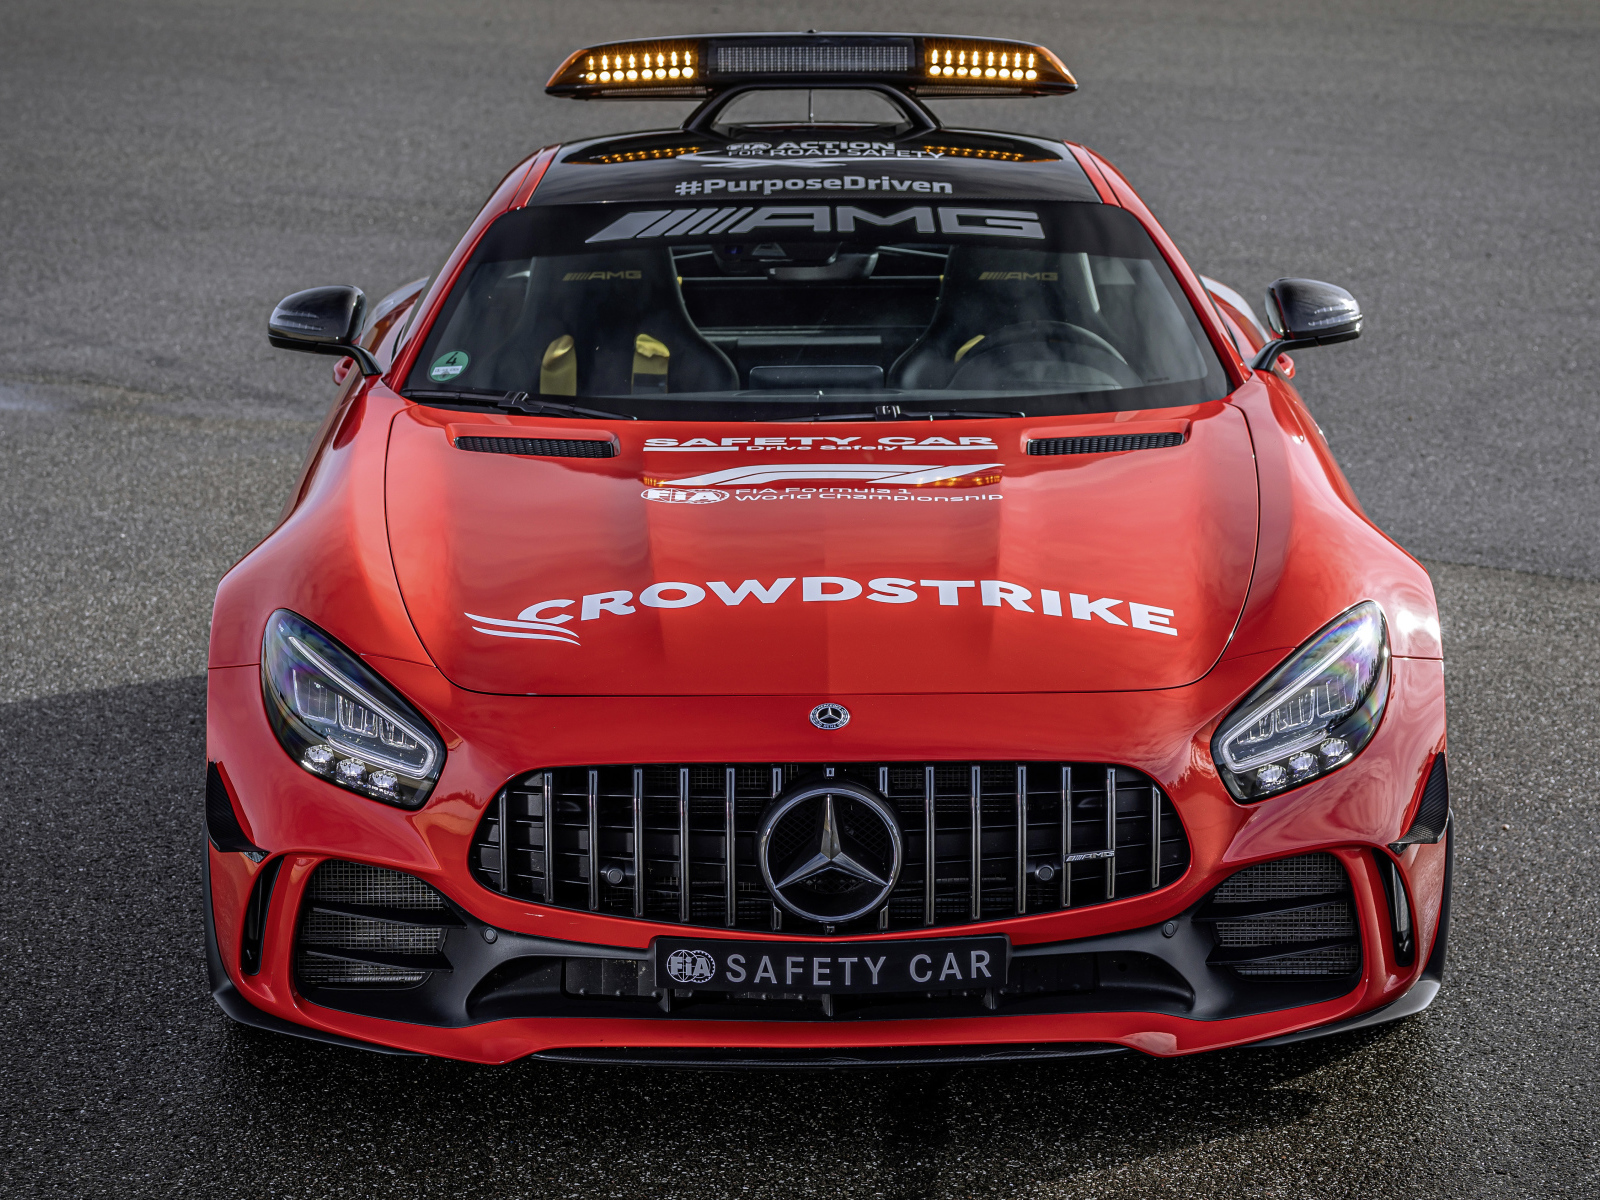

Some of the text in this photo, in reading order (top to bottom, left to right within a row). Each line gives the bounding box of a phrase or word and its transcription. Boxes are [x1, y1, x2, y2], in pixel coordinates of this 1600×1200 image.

[776, 141, 896, 150] ACTION
[770, 149, 840, 157] ROAD
[847, 149, 945, 159] SAFETY
[674, 175, 953, 196] #PurposeDriven
[728, 205, 1046, 239] AMG
[588, 270, 643, 280] AMG
[1004, 271, 1059, 281] AMG
[445, 352, 459, 366] 4
[644, 436, 997, 446] SAFETY CAR
[734, 493, 1004, 502] World Championship
[517, 576, 1179, 637] CROWDSTRIKE
[725, 953, 887, 987] SAFETY
[908, 950, 993, 983] CAR
